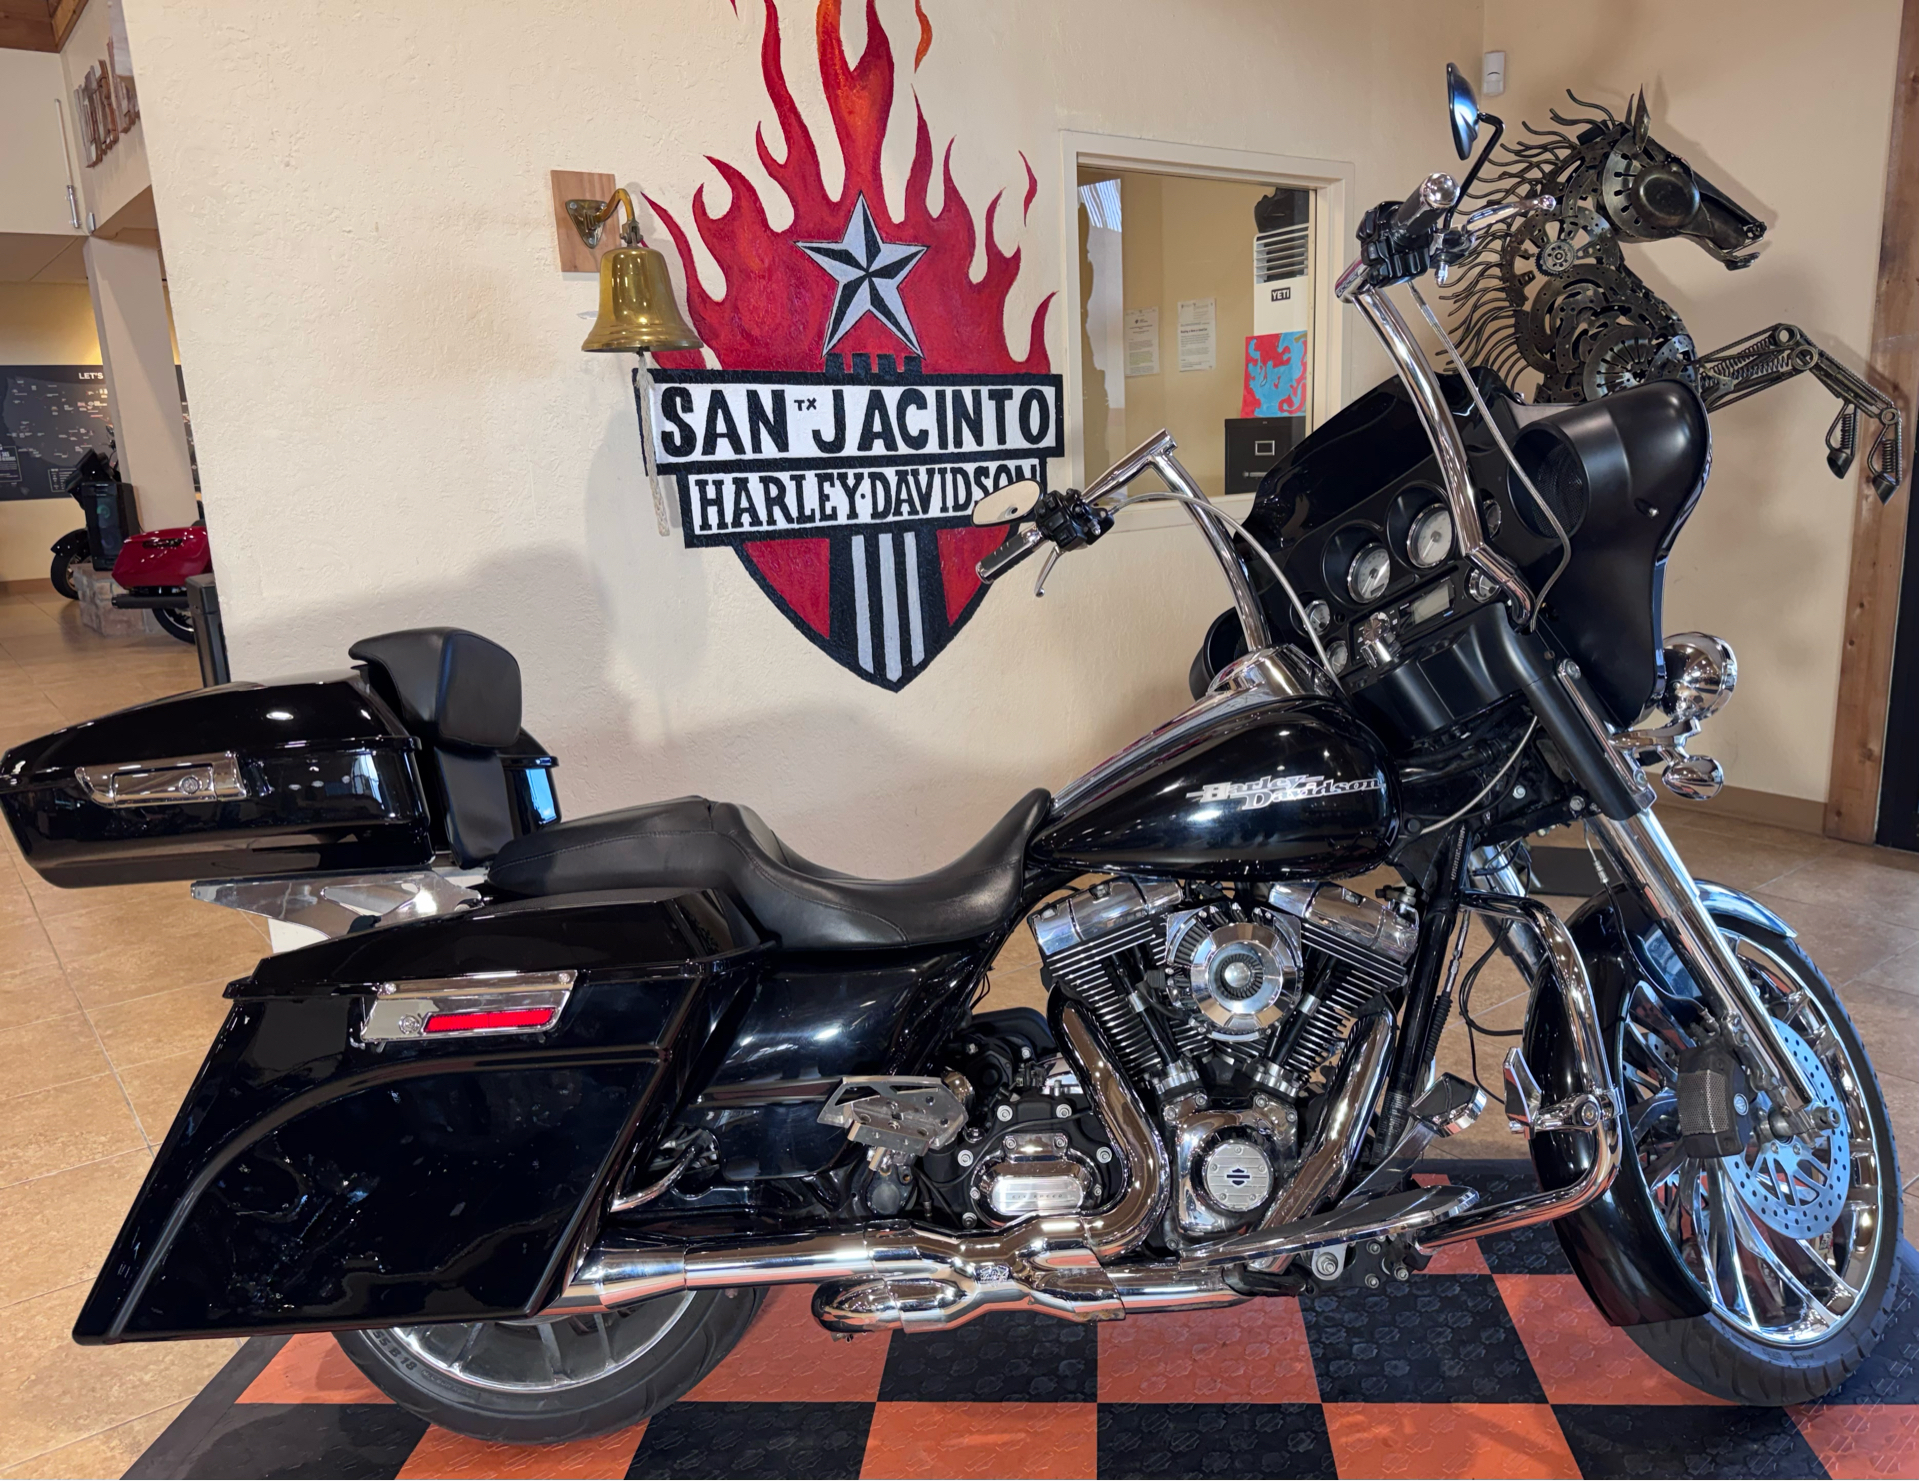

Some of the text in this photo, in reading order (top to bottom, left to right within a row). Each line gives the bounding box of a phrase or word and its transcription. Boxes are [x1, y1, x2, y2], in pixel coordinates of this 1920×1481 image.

[1272, 289, 1290, 300] YETI
[661, 387, 1051, 457] SAN TX JACINTO
[1199, 774, 1312, 802] Harley
[1240, 778, 1384, 811] Davidson
